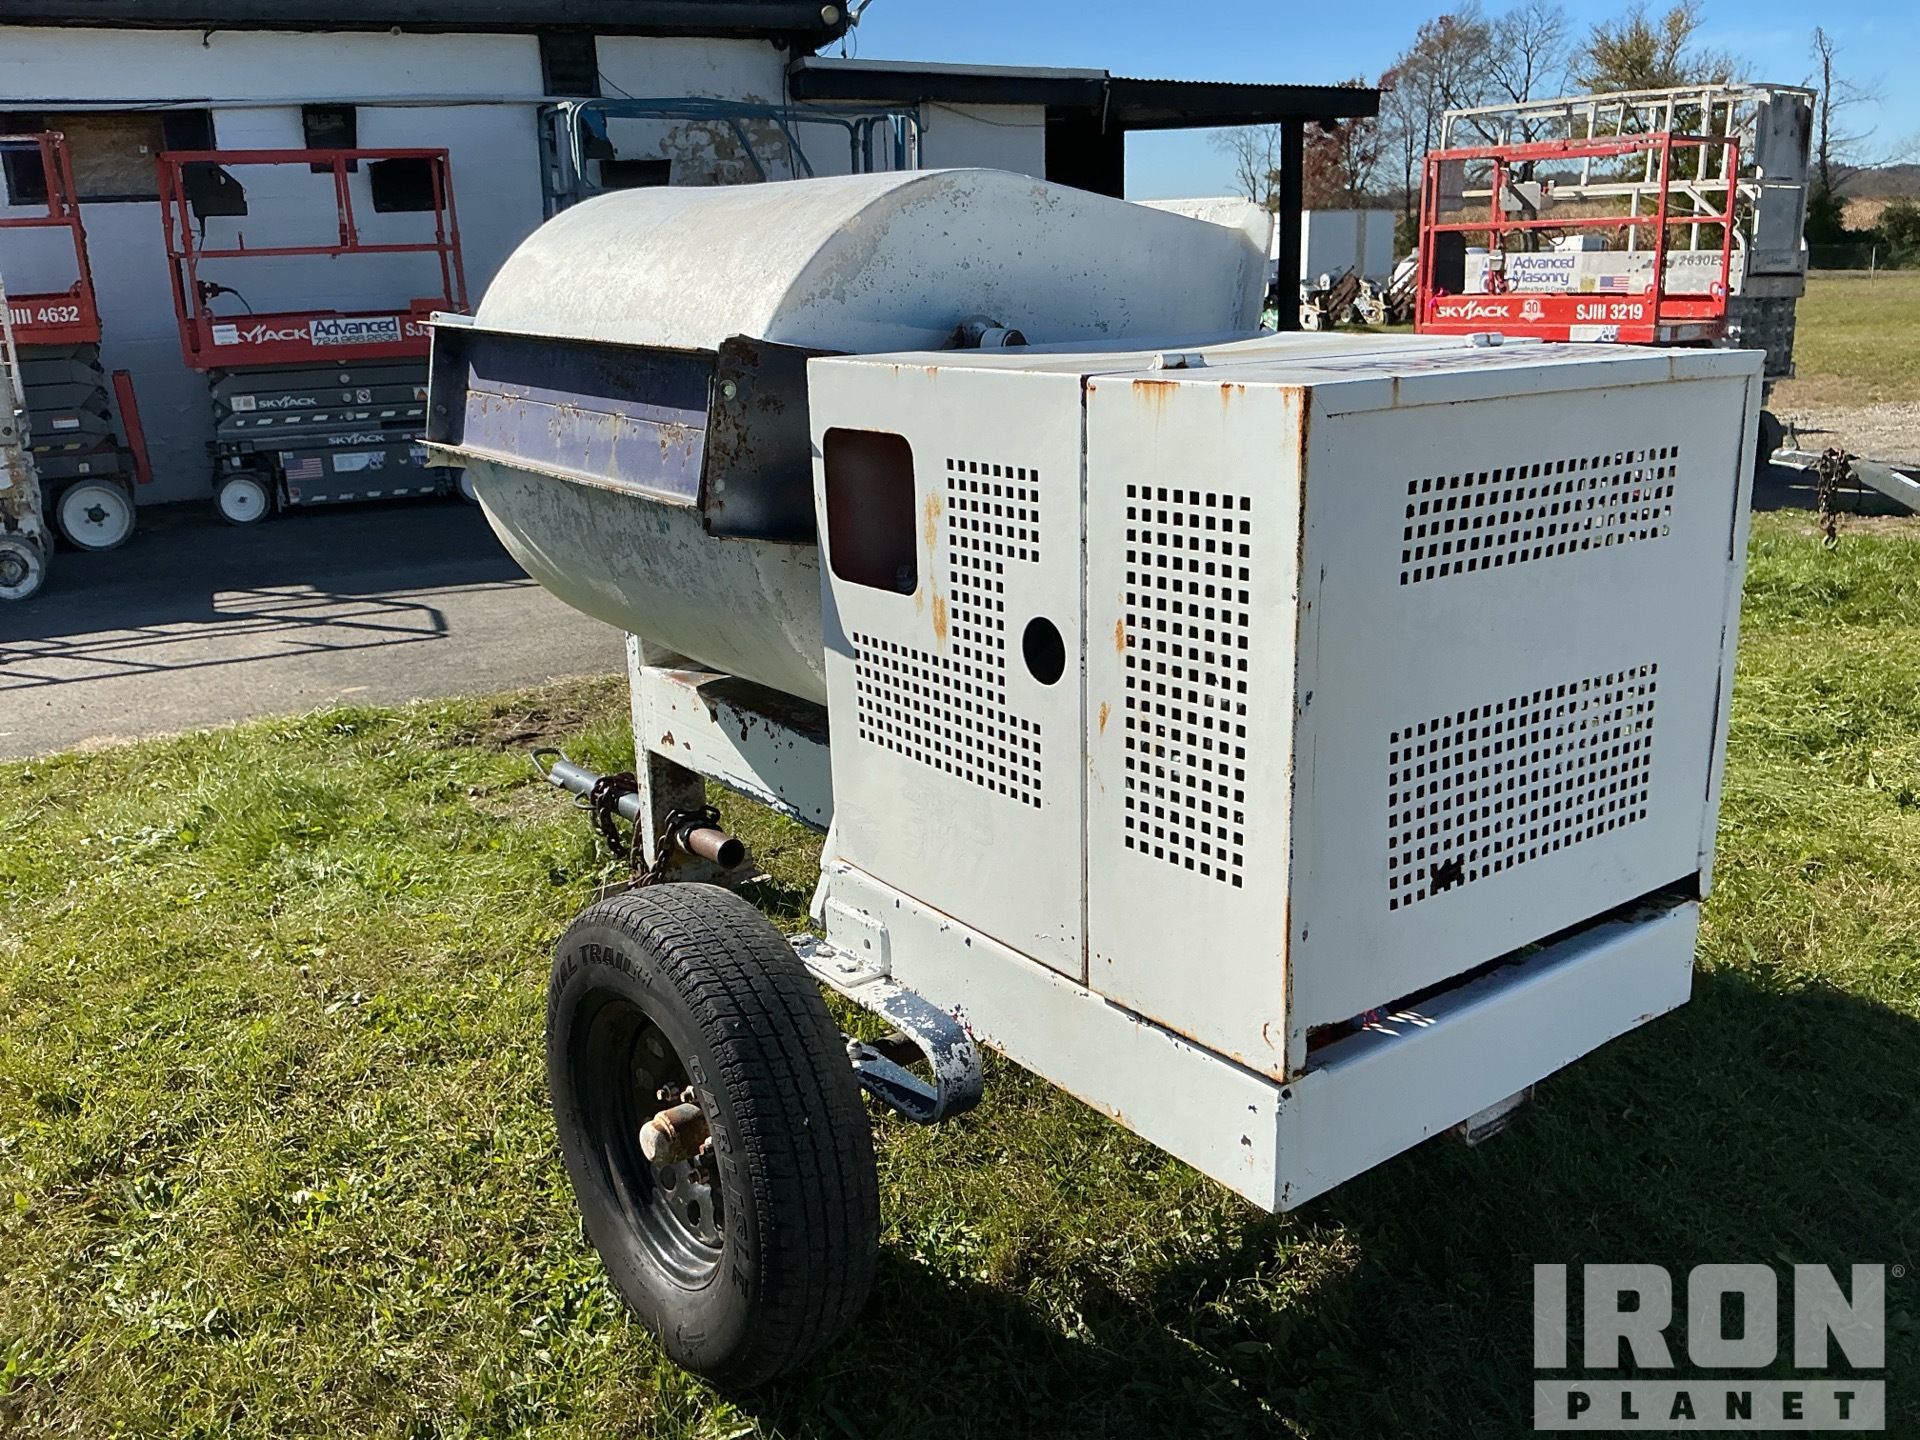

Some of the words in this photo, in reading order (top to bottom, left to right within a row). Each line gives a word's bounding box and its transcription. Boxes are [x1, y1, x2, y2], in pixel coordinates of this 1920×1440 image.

[1513, 256, 1575, 269] Advanced
[1513, 270, 1569, 286] Masonry
[9, 309, 32, 325] JIII
[37, 306, 79, 323] 4632
[1436, 300, 1509, 320] SKYJACK
[1526, 302, 1538, 313] 30
[1610, 303, 1643, 320] 3219
[313, 317, 397, 337] Advanced
[258, 396, 317, 409] SKYJACK
[328, 432, 385, 445] SKYJACK
[579, 943, 636, 983] TRAIL
